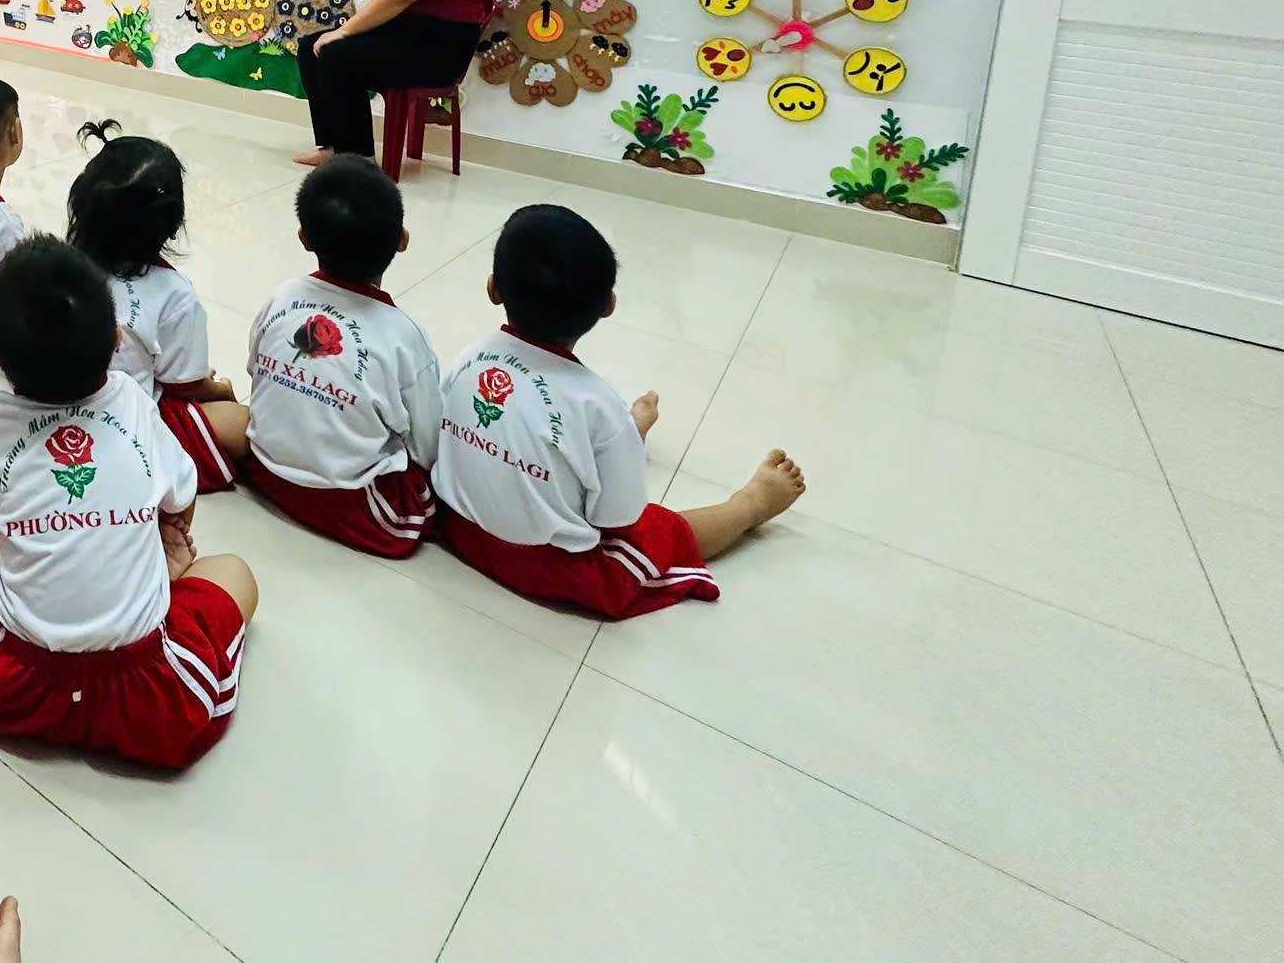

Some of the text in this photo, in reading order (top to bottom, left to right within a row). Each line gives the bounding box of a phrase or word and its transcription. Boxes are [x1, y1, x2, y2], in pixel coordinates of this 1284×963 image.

[282, 363, 307, 383] XÃ
[310, 375, 358, 406] LAGI
[503, 449, 550, 482] LAGI
[6, 509, 102, 537] PHƯỜNG
